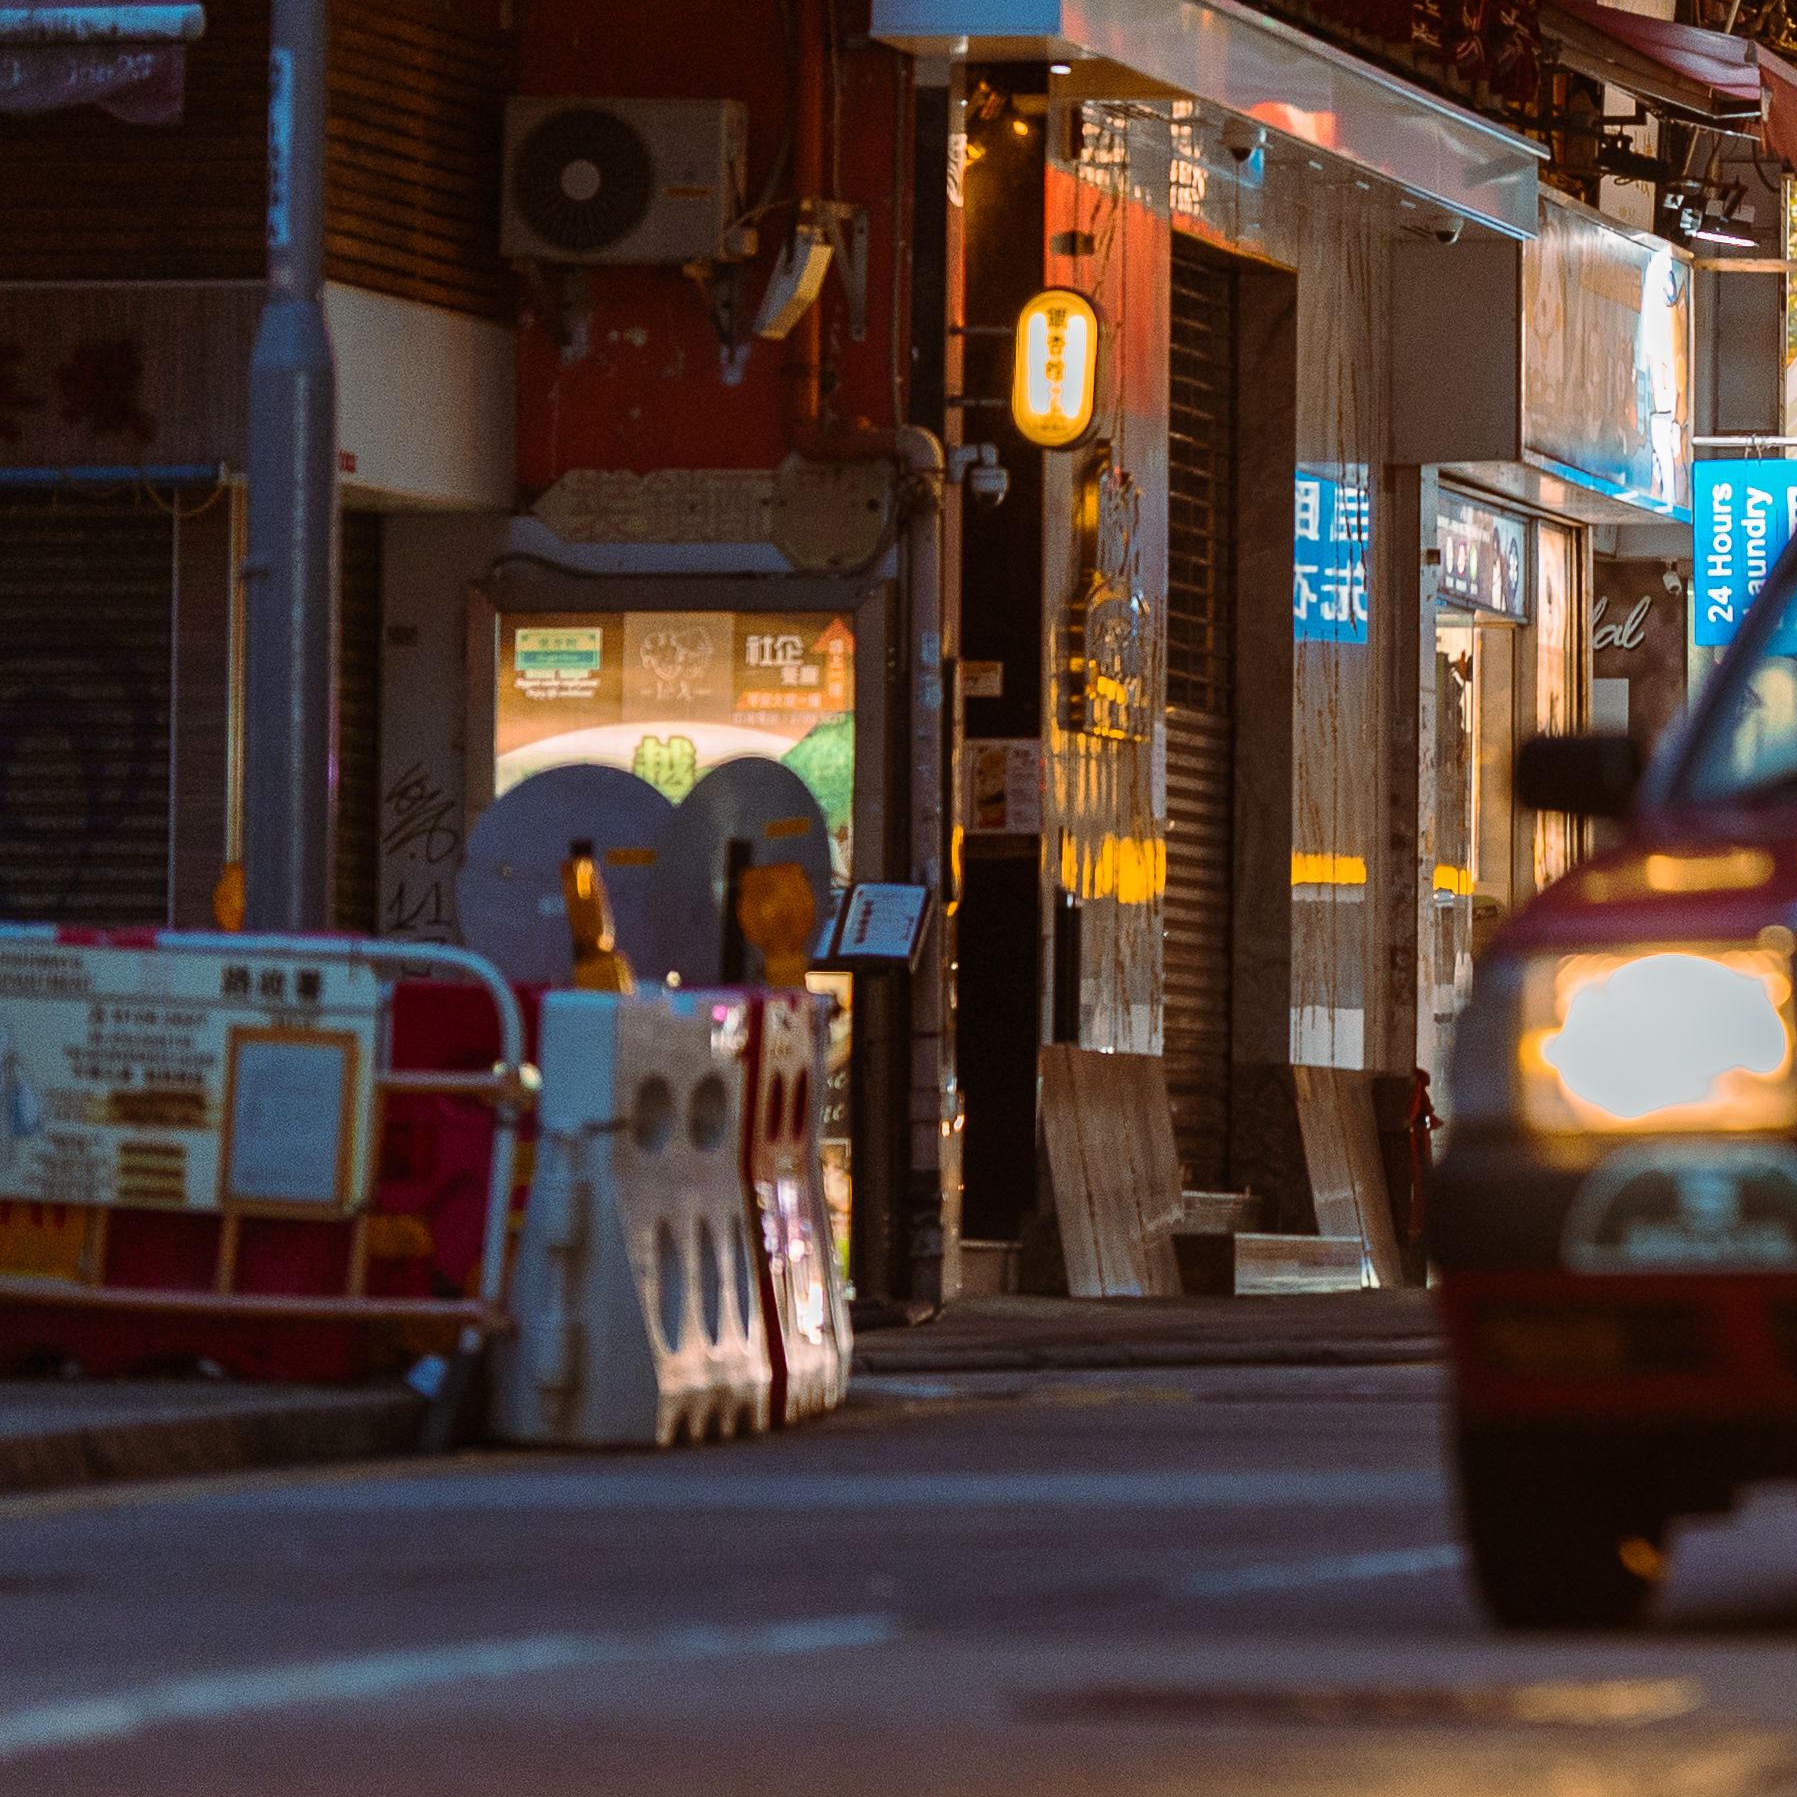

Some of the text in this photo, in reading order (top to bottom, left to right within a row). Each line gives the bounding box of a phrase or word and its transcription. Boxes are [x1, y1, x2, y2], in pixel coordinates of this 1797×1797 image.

[1706, 482, 1733, 624] 24 Hours
[1741, 487, 1773, 612] aundry
